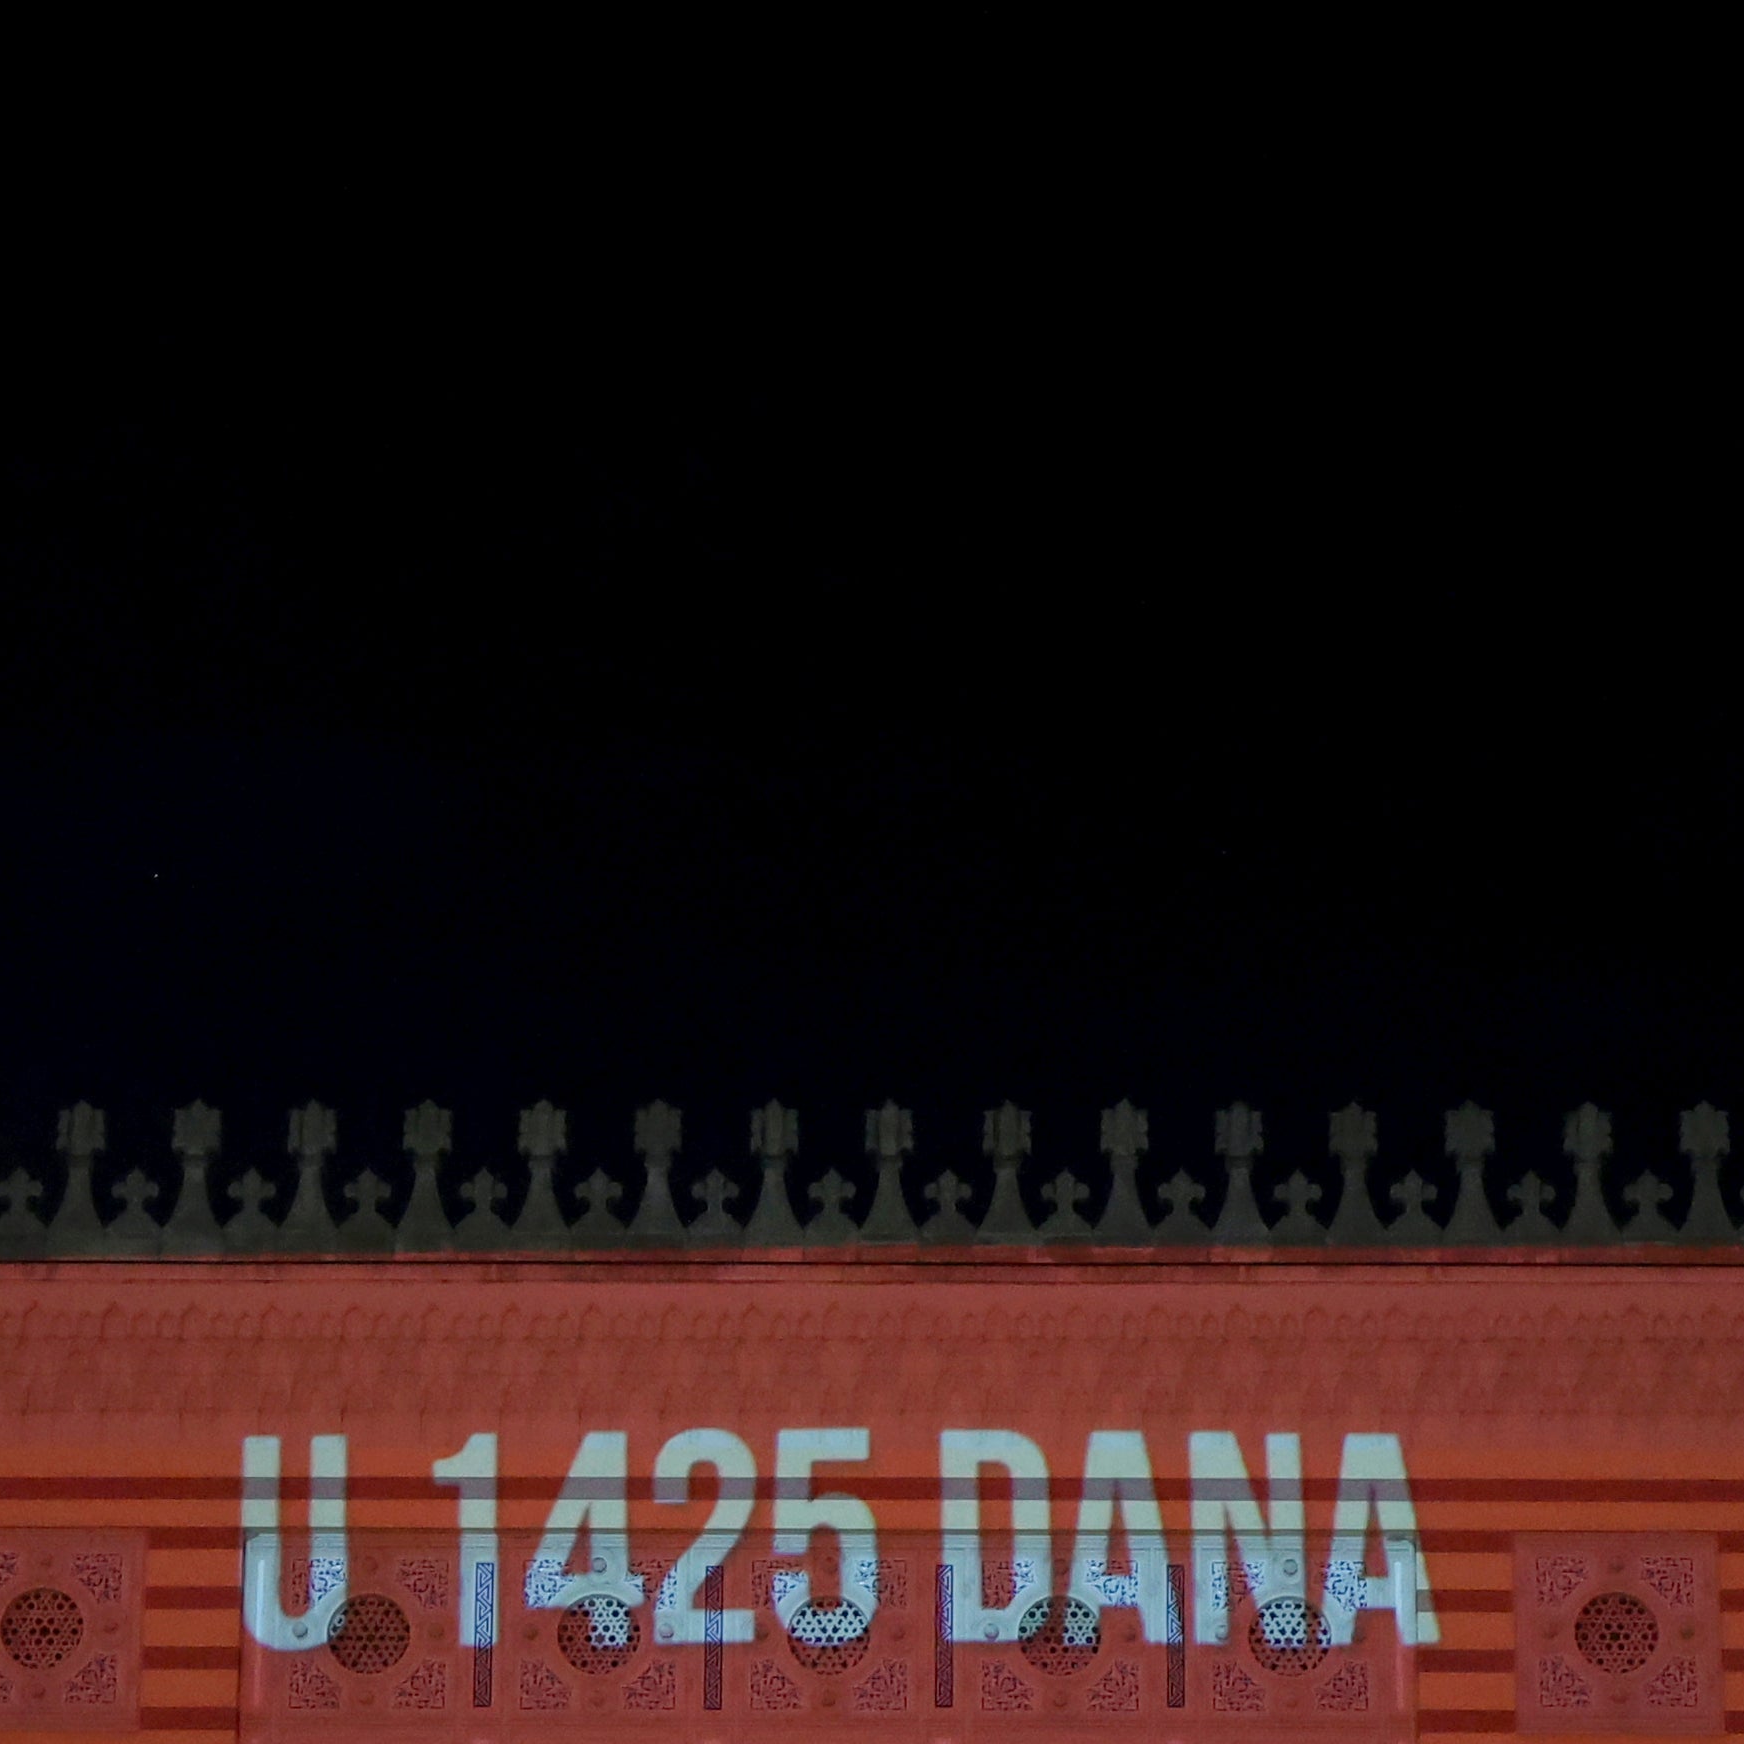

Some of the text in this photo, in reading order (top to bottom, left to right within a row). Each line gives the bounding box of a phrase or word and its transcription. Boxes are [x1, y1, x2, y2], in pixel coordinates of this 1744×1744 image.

[240, 1427, 1441, 1650] U 1425 DANA
